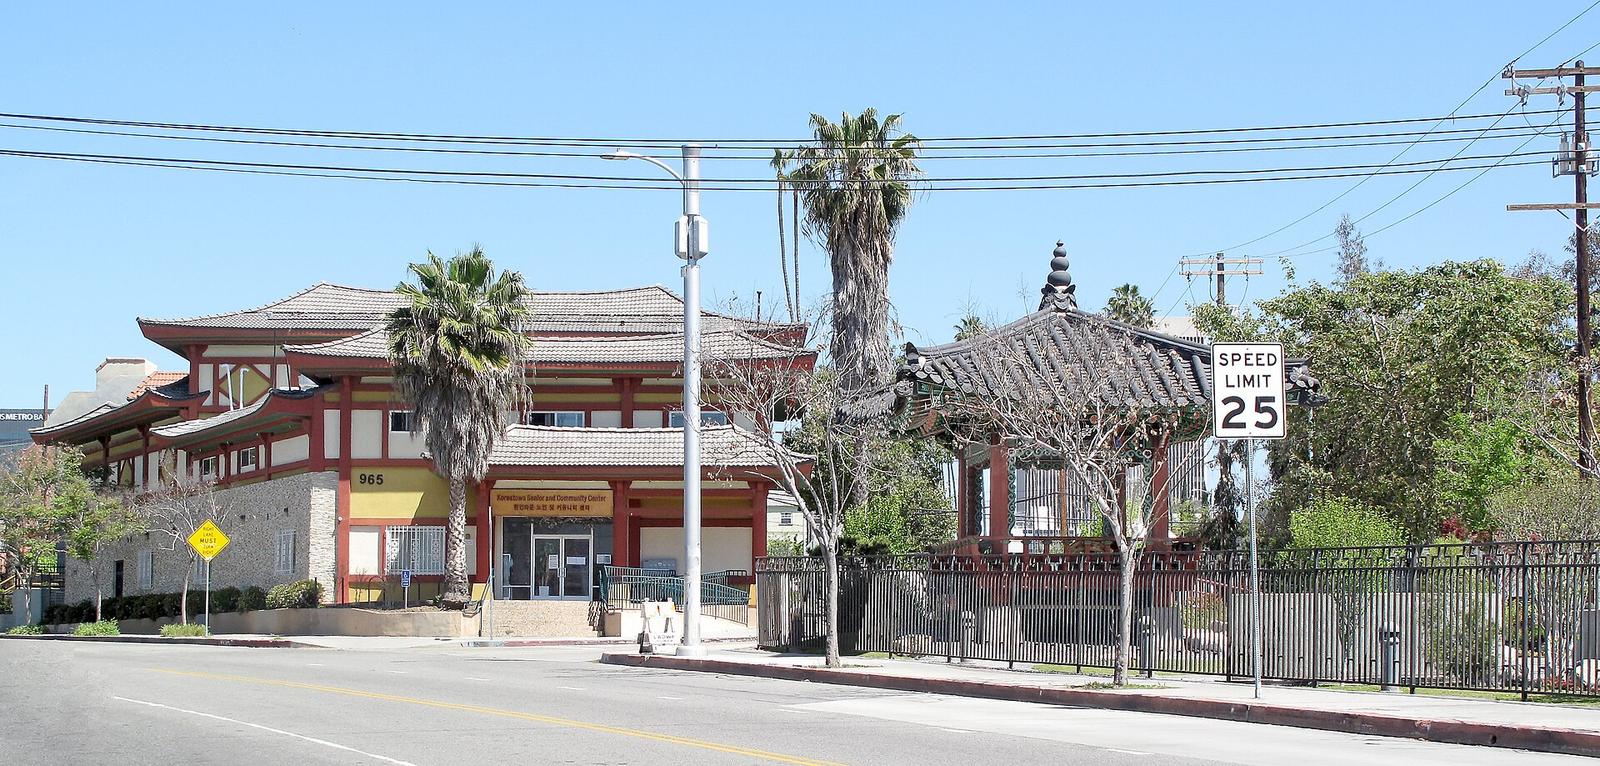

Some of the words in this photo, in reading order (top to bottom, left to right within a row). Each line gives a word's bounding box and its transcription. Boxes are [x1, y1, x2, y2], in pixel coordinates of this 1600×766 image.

[1219, 353, 1277, 366] SPEED
[1225, 374, 1271, 388] LIMIT
[1221, 396, 1278, 429] 25
[359, 473, 384, 485] 965
[527, 494, 544, 502] Senior
[546, 494, 555, 502] and
[556, 494, 587, 503] Community
[588, 494, 607, 502] Center
